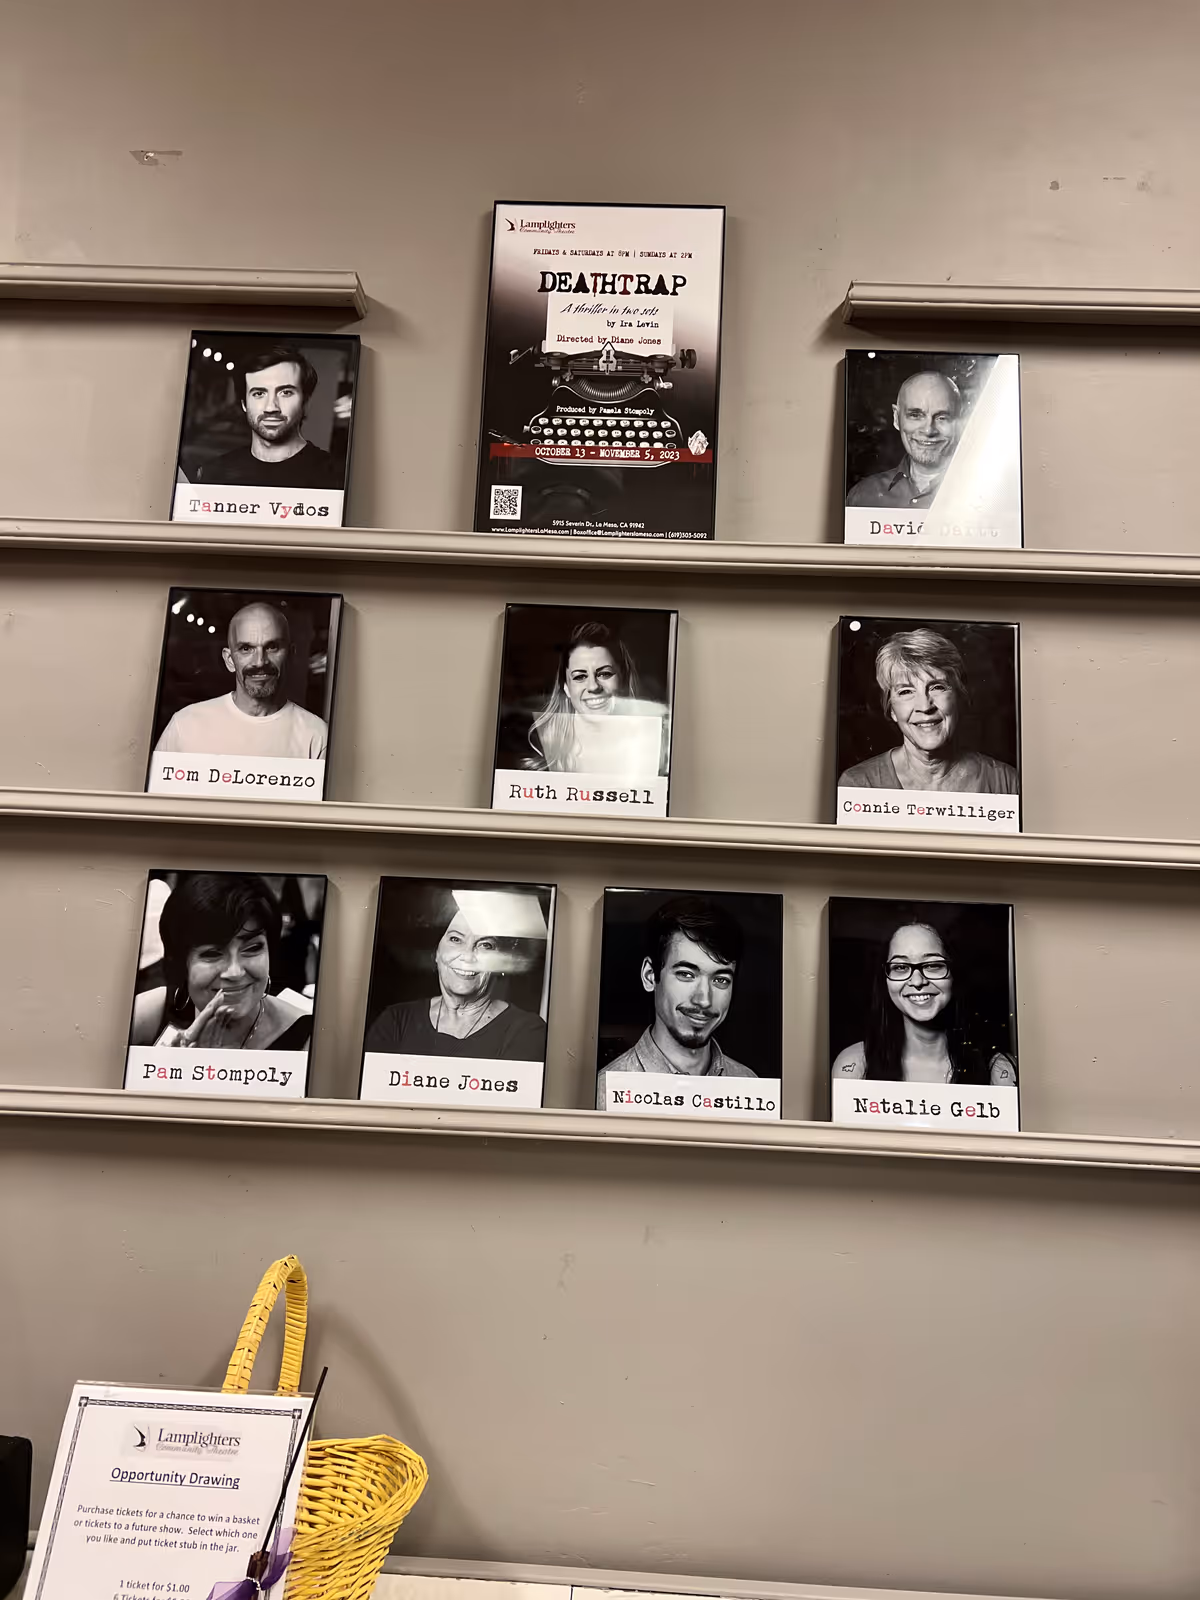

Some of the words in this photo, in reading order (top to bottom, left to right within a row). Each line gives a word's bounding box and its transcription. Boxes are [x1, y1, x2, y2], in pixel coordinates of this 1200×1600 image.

[520, 219, 576, 230] Lamplighters
[533, 248, 560, 256] FRIDAYS
[569, 249, 604, 257] SATURDAYS
[537, 270, 687, 297] DEATHTRAP
[560, 303, 573, 314] A
[572, 302, 608, 315] thriller
[609, 304, 620, 315] in
[621, 306, 640, 316] two
[606, 320, 616, 328] by
[636, 320, 660, 328] Levin
[556, 334, 594, 343] Directed
[597, 336, 608, 345] by
[611, 336, 634, 344] Diane
[638, 336, 662, 345] Jones
[556, 406, 586, 414] Produced
[624, 407, 655, 416] Stompoly
[535, 447, 572, 456] OCTOBER
[575, 448, 586, 458] 13
[600, 448, 641, 459] NOVEMBER
[644, 449, 654, 461] 5,
[660, 450, 680, 460] 2023
[190, 500, 260, 514] Tanner
[269, 502, 330, 519] Vydos
[162, 766, 199, 782] Tom
[208, 768, 316, 788] DeLorenzo
[508, 784, 558, 800] Ruth
[566, 787, 654, 804] Russell
[843, 800, 900, 814] Connie
[906, 804, 1016, 822] Terwilliger
[142, 1064, 182, 1080] Pam
[192, 1065, 293, 1086] Stompoly
[388, 1070, 450, 1088] Diane
[458, 1074, 519, 1092] Jones
[612, 1090, 685, 1106] Nicolas
[692, 1094, 776, 1112] Castillo
[852, 1098, 941, 1116] Natalie
[950, 1102, 1000, 1118] Gelb
[157, 1428, 241, 1448] Lamplighters
[110, 1467, 186, 1486] Opportunity
[189, 1472, 240, 1490] Drawing
[77, 1504, 114, 1515] Purchase
[116, 1507, 143, 1517] tickets
[145, 1509, 158, 1518] for
[166, 1510, 195, 1520] chance
[197, 1514, 206, 1522] to
[208, 1514, 224, 1522] win
[232, 1515, 260, 1525] basket
[84, 1519, 112, 1529] tickets
[114, 1522, 122, 1530] to
[132, 1522, 158, 1532] future
[159, 1524, 184, 1534] show.
[188, 1526, 213, 1536] Select
[215, 1528, 240, 1538] which
[242, 1531, 258, 1540] one
[86, 1534, 102, 1543] you
[103, 1534, 118, 1544] like
[120, 1536, 136, 1544] and
[137, 1538, 152, 1548] put
[154, 1538, 178, 1548] ticket
[179, 1540, 198, 1550] stub
[200, 1541, 208, 1550] in
[210, 1542, 224, 1552] the
[224, 1542, 240, 1554] jar.
[120, 1579, 124, 1588] 1
[126, 1580, 150, 1590] ticket
[152, 1581, 165, 1592] for
[166, 1582, 190, 1593] $1.00
